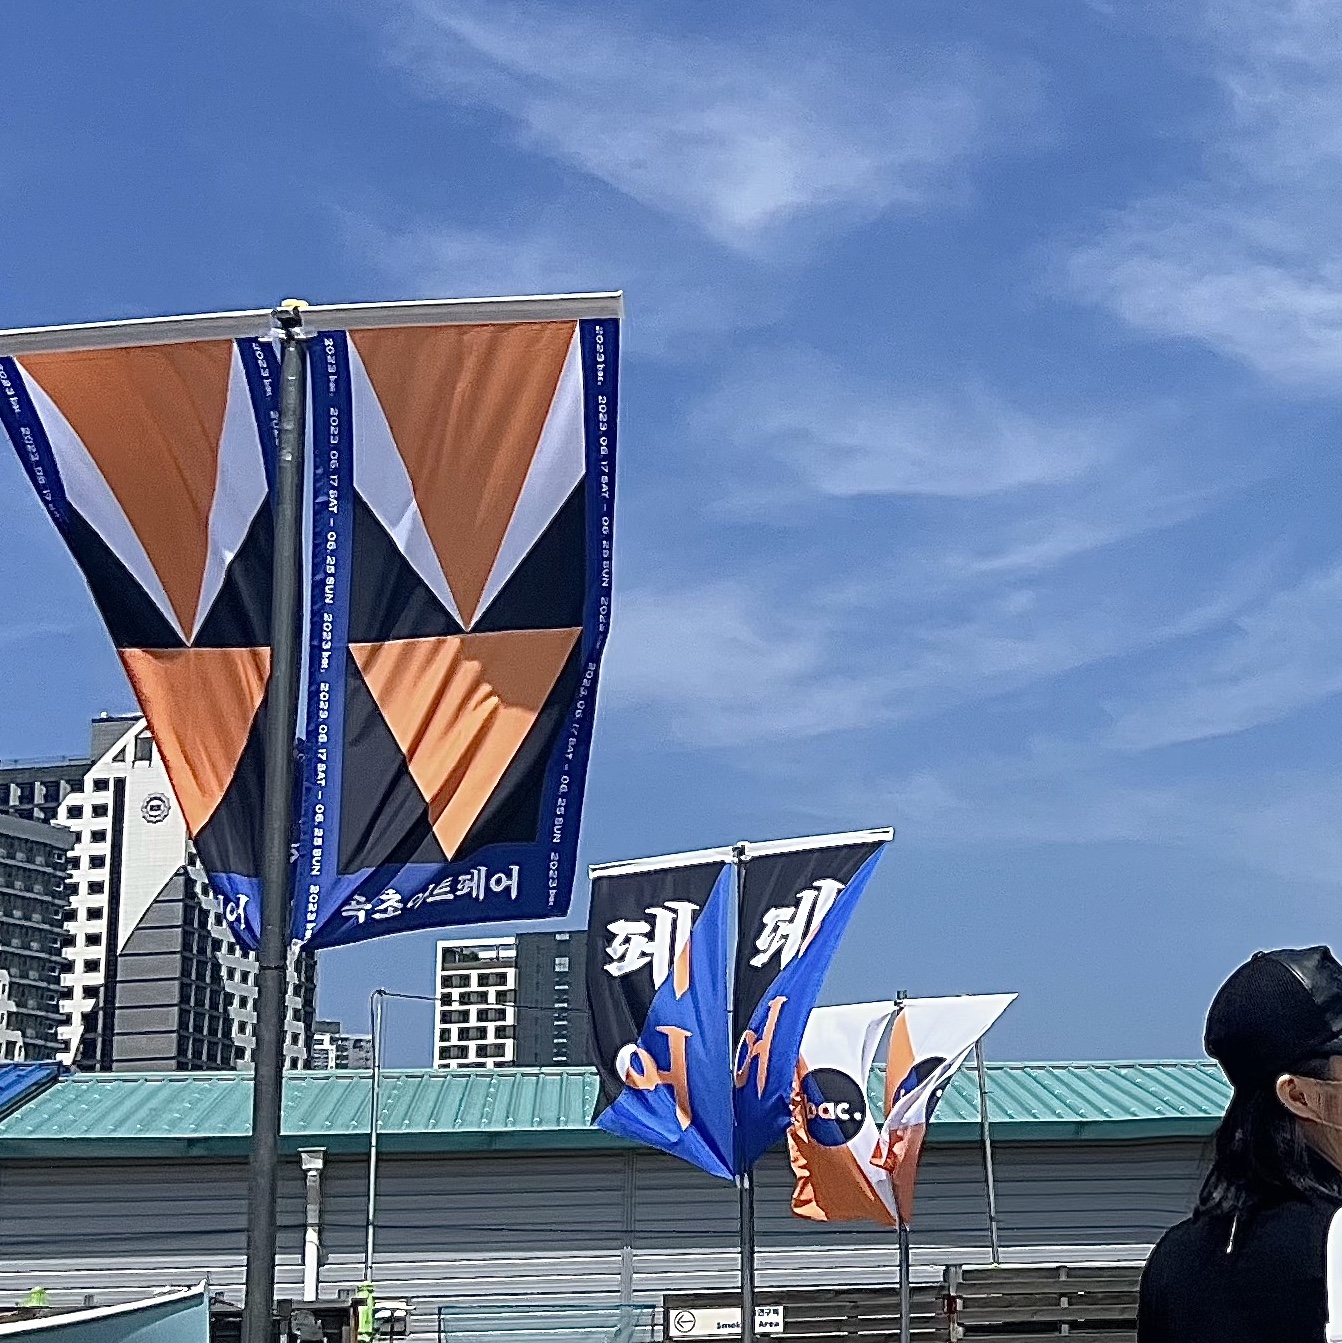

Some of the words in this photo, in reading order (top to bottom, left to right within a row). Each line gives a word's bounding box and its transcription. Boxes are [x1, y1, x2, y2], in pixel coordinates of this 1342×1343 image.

[324, 338, 336, 373] 2023
[595, 325, 605, 362] 2023
[600, 475, 610, 499] SAT
[328, 489, 338, 513] SAT
[326, 555, 336, 574] 25
[601, 560, 610, 587] SUN
[324, 576, 336, 604] SUN
[321, 612, 333, 650] 2023
[565, 737, 577, 761] SAT
[316, 763, 327, 787] SAT
[556, 797, 567, 815] 25
[313, 827, 324, 846] 25
[552, 817, 564, 843] SUN
[310, 848, 322, 876] SUN
[548, 851, 560, 888] 2023
[307, 884, 320, 920] 2023
[758, 1320, 780, 1328] Area
